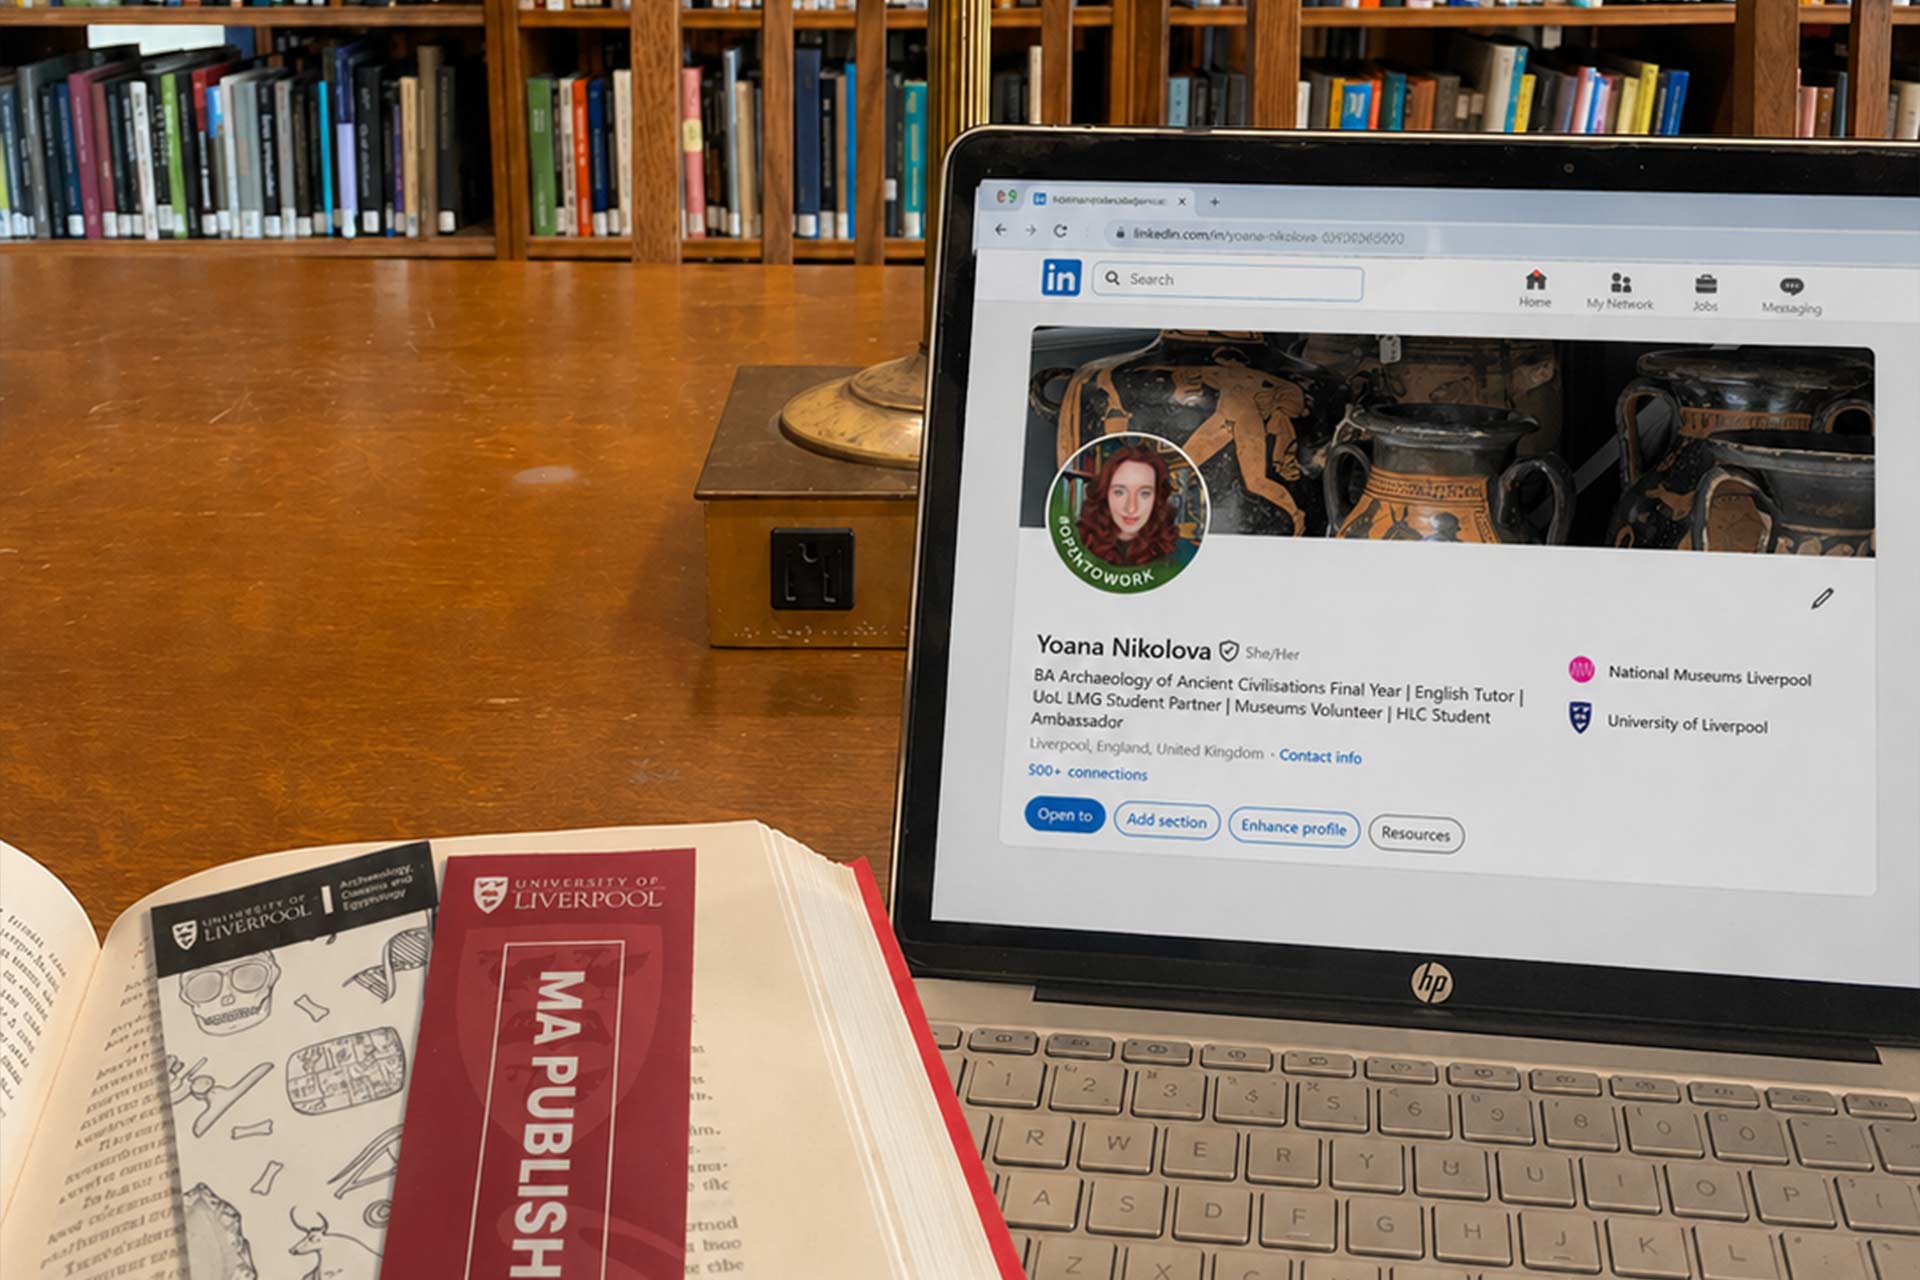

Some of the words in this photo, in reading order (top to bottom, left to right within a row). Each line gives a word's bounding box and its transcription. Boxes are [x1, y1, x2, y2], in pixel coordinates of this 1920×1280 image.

[1046, 263, 1077, 292] in
[1130, 273, 1174, 286] Search
[1519, 297, 1551, 308] Home
[1587, 298, 1603, 310] My
[1607, 298, 1654, 310] Network
[1693, 301, 1718, 312] Jobs
[1762, 302, 1822, 316] Messaging
[1037, 634, 1104, 655] Yoana
[1112, 637, 1211, 660] Nikolova
[1246, 645, 1300, 661] She/Her
[1034, 668, 1054, 682] BA
[1059, 670, 1152, 690] Archaeology
[1156, 673, 1173, 687] of
[1177, 675, 1233, 690] Ancient
[1238, 676, 1325, 695] Civilisations
[1330, 681, 1365, 697] Final
[1369, 683, 1401, 698] Year
[1415, 686, 1468, 704] English
[1474, 687, 1514, 702] Tutor
[1609, 665, 1669, 681] National
[1673, 668, 1742, 684] Museums
[1747, 671, 1812, 688] Liverpool
[1032, 690, 1062, 705] UoL
[1067, 692, 1102, 706] LMG
[1106, 693, 1164, 710] Student
[1169, 696, 1221, 711] Partner
[1235, 699, 1306, 716] Museums
[1311, 702, 1383, 719] Volunteer
[1396, 707, 1427, 722] HLC
[1431, 708, 1491, 724] Student
[1030, 712, 1124, 729] Ambassador
[1608, 714, 1678, 733] University
[1683, 717, 1698, 731] of
[1702, 718, 1768, 736] Liverpool
[1029, 737, 1093, 754] Liverpool,
[1097, 739, 1152, 757] England,
[1156, 743, 1200, 757] United
[1204, 744, 1264, 762] Kingdom
[1279, 748, 1332, 763] Contact
[1336, 751, 1363, 765] info
[1028, 763, 1062, 777] 500+
[1067, 766, 1149, 782] connections
[1037, 807, 1075, 825] Open
[1078, 809, 1093, 823] to
[1126, 813, 1155, 827] Add
[1158, 814, 1208, 830] section
[1241, 819, 1299, 834] Enhance
[1303, 821, 1347, 838] profile
[1381, 826, 1451, 843] Resources
[515, 877, 628, 889] UNIVERSITY
[635, 876, 659, 887] OF
[514, 890, 663, 909] LIVERPOOL
[204, 905, 313, 942] LIVERPOOL
[533, 971, 586, 1045] MA
[1082, 1077, 1097, 1092] 2
[1163, 1083, 1178, 1098] 3
[1026, 1128, 1045, 1146] R
[1107, 1135, 1131, 1152] W
[1193, 1141, 1207, 1158] E
[1276, 1147, 1291, 1163] R
[1360, 1153, 1375, 1169] Y
[509, 1056, 579, 1278] PUBLISH
[1033, 1189, 1051, 1206] A
[1120, 1196, 1134, 1213] S
[1205, 1202, 1222, 1219] D
[1291, 1208, 1306, 1225] F
[1377, 1215, 1394, 1233] G
[1463, 1222, 1482, 1240] H
[1554, 1231, 1567, 1247] J
[1639, 1237, 1657, 1255] K
[1728, 1244, 1747, 1262] L
[1065, 1256, 1083, 1274] Z
